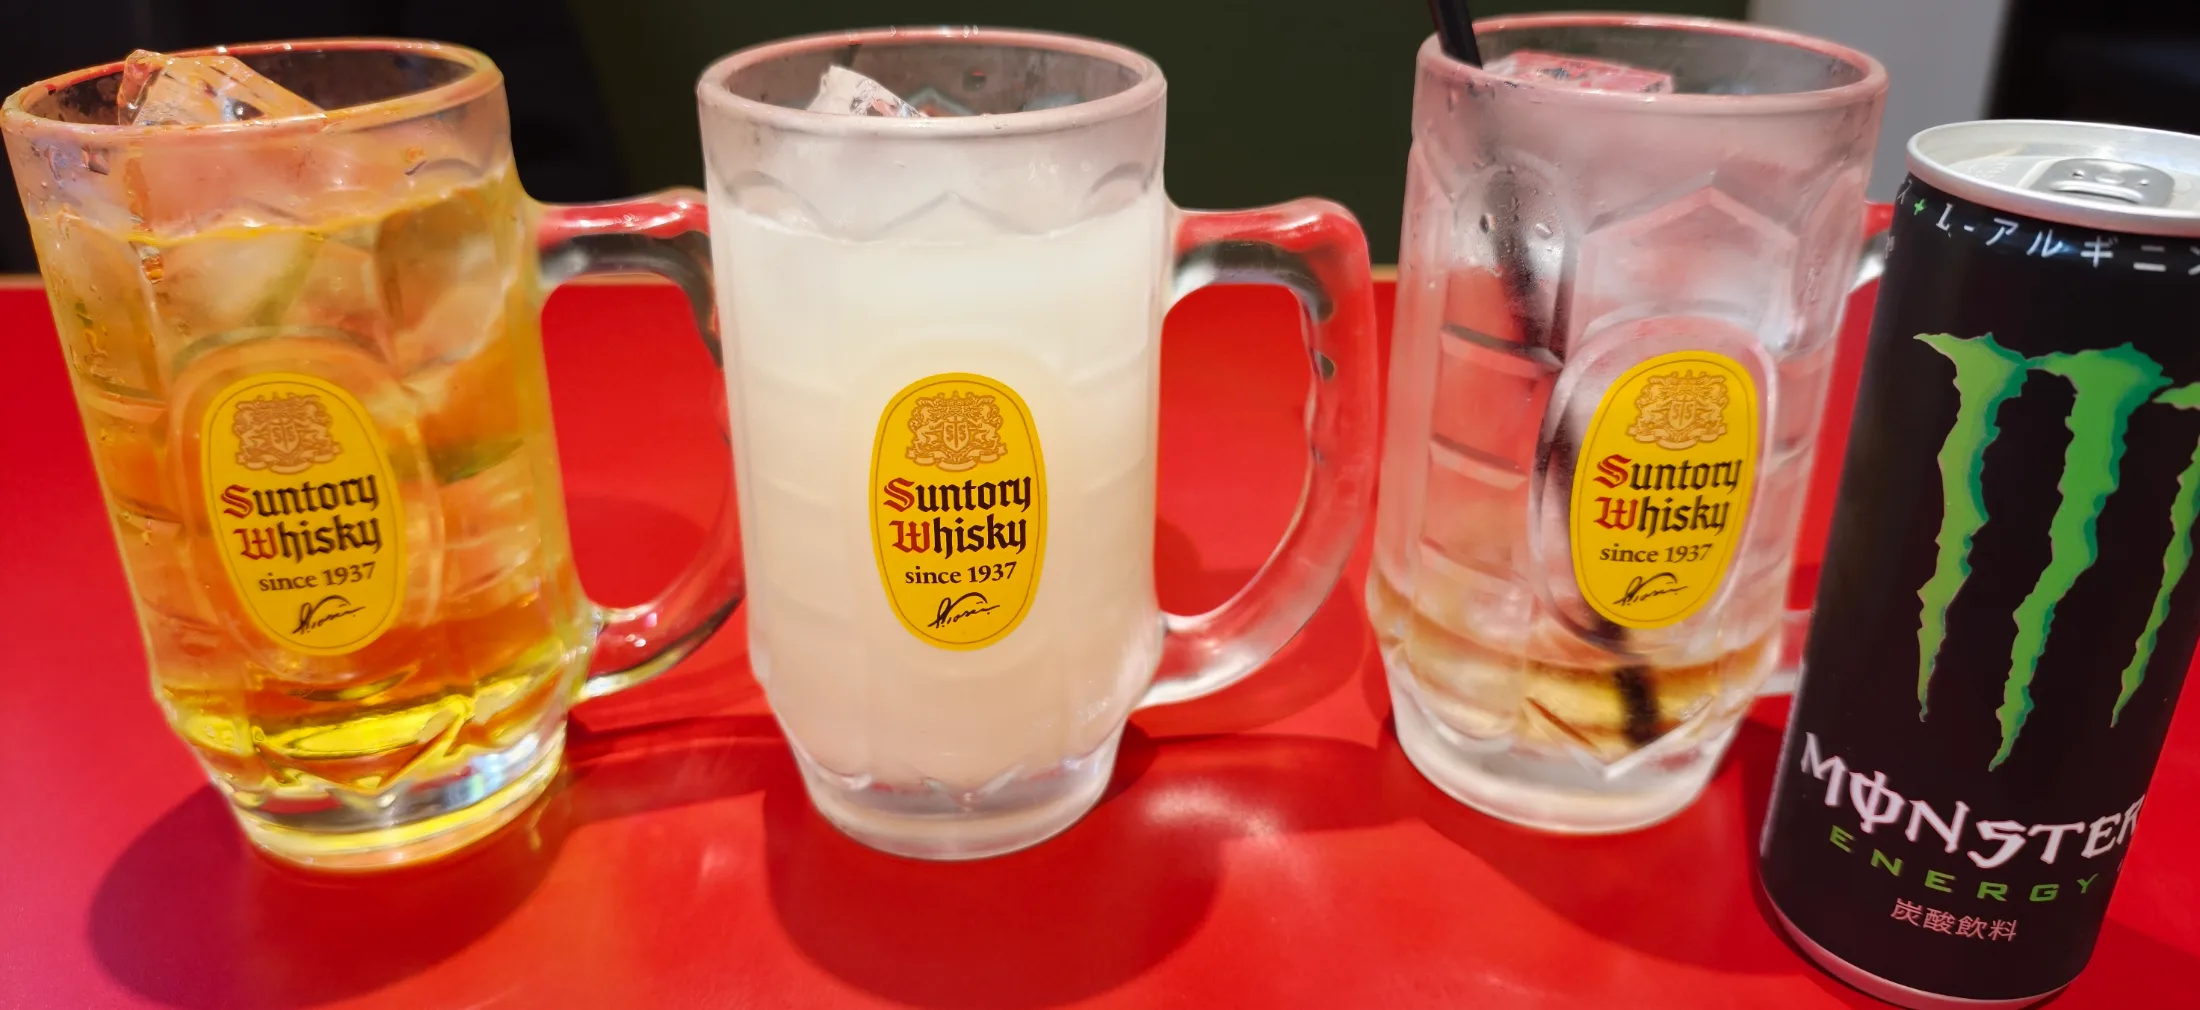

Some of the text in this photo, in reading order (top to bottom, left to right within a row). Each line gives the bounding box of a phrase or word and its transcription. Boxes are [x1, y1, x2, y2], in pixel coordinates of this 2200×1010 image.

[883, 476, 1032, 513] Suntory
[1593, 454, 1743, 494] Suntory
[221, 474, 380, 519] Suntory
[1593, 494, 1730, 538] Whisky
[233, 514, 383, 563] Whisky
[888, 514, 1027, 560] Whisky
[1599, 543, 1713, 563] since 1937
[259, 561, 376, 592] since 1937
[905, 561, 1017, 585] since 1937
[1829, 824, 2099, 902] ENERGY
[1890, 897, 2018, 941] 炭酸飲料
